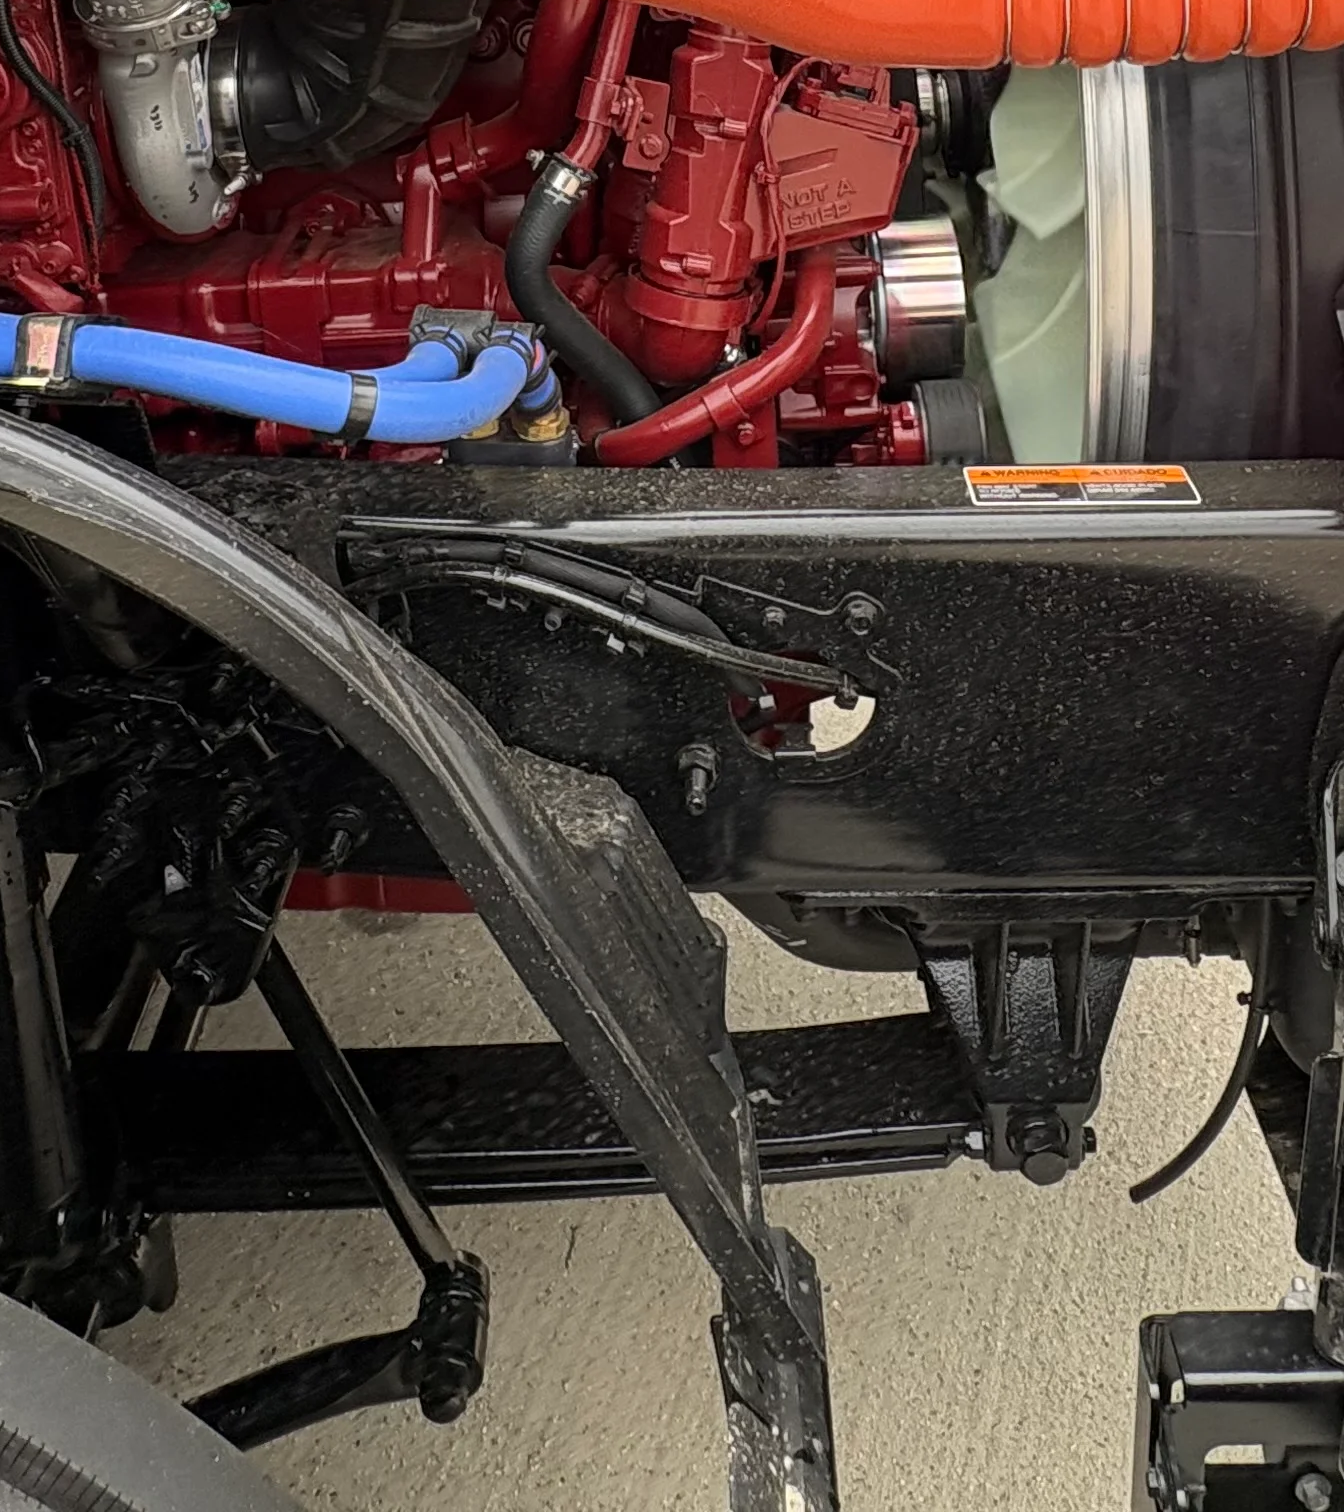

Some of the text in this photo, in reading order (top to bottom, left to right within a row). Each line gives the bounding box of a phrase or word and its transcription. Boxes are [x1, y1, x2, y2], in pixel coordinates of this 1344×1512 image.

[781, 177, 857, 209] NOT A
[788, 199, 852, 229] STEP
[992, 469, 1060, 477] WARNING
